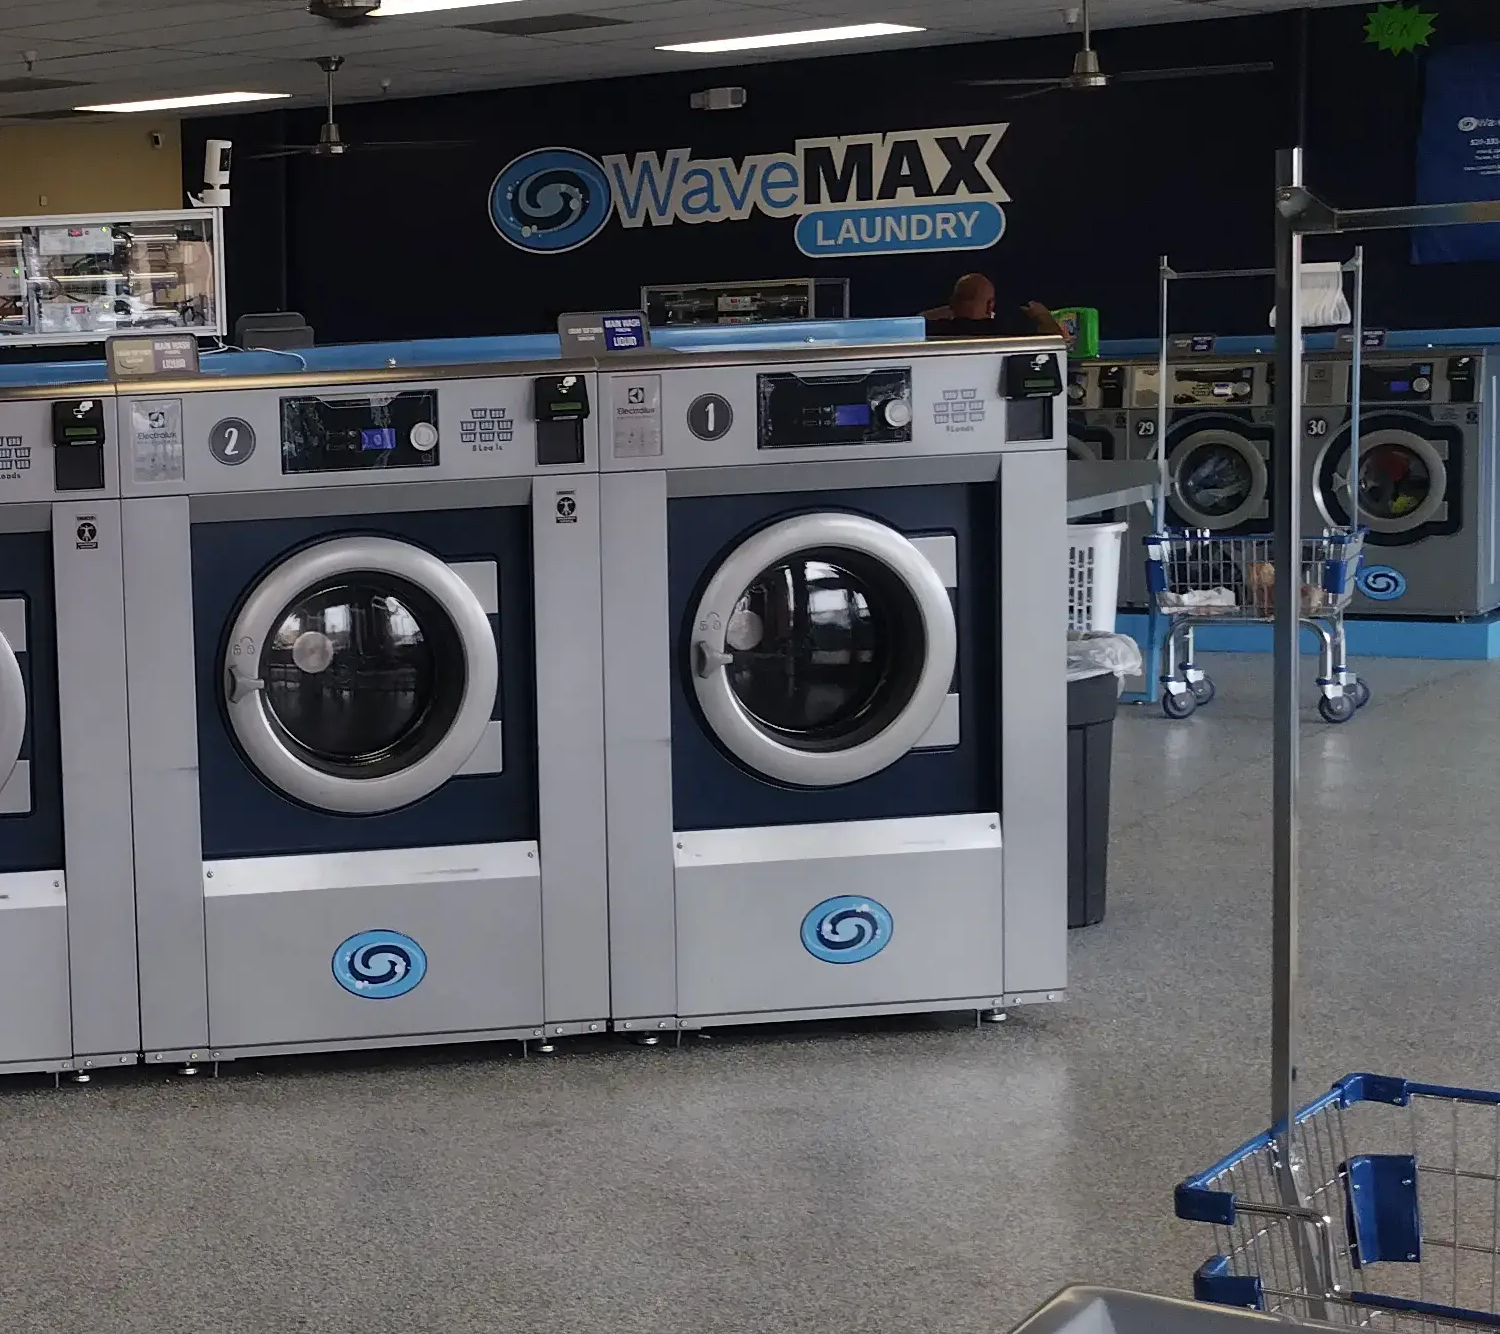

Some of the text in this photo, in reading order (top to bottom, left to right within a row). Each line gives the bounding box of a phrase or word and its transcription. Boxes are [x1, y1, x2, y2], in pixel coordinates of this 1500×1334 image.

[611, 134, 993, 218] WaveMAX
[815, 210, 980, 246] LAUNDRY
[617, 407, 656, 415] Electrolux
[704, 402, 715, 432] 1
[137, 431, 177, 439] Electrolux
[1138, 421, 1155, 436] 29
[1308, 418, 1327, 435] 30
[224, 427, 239, 456] 2
